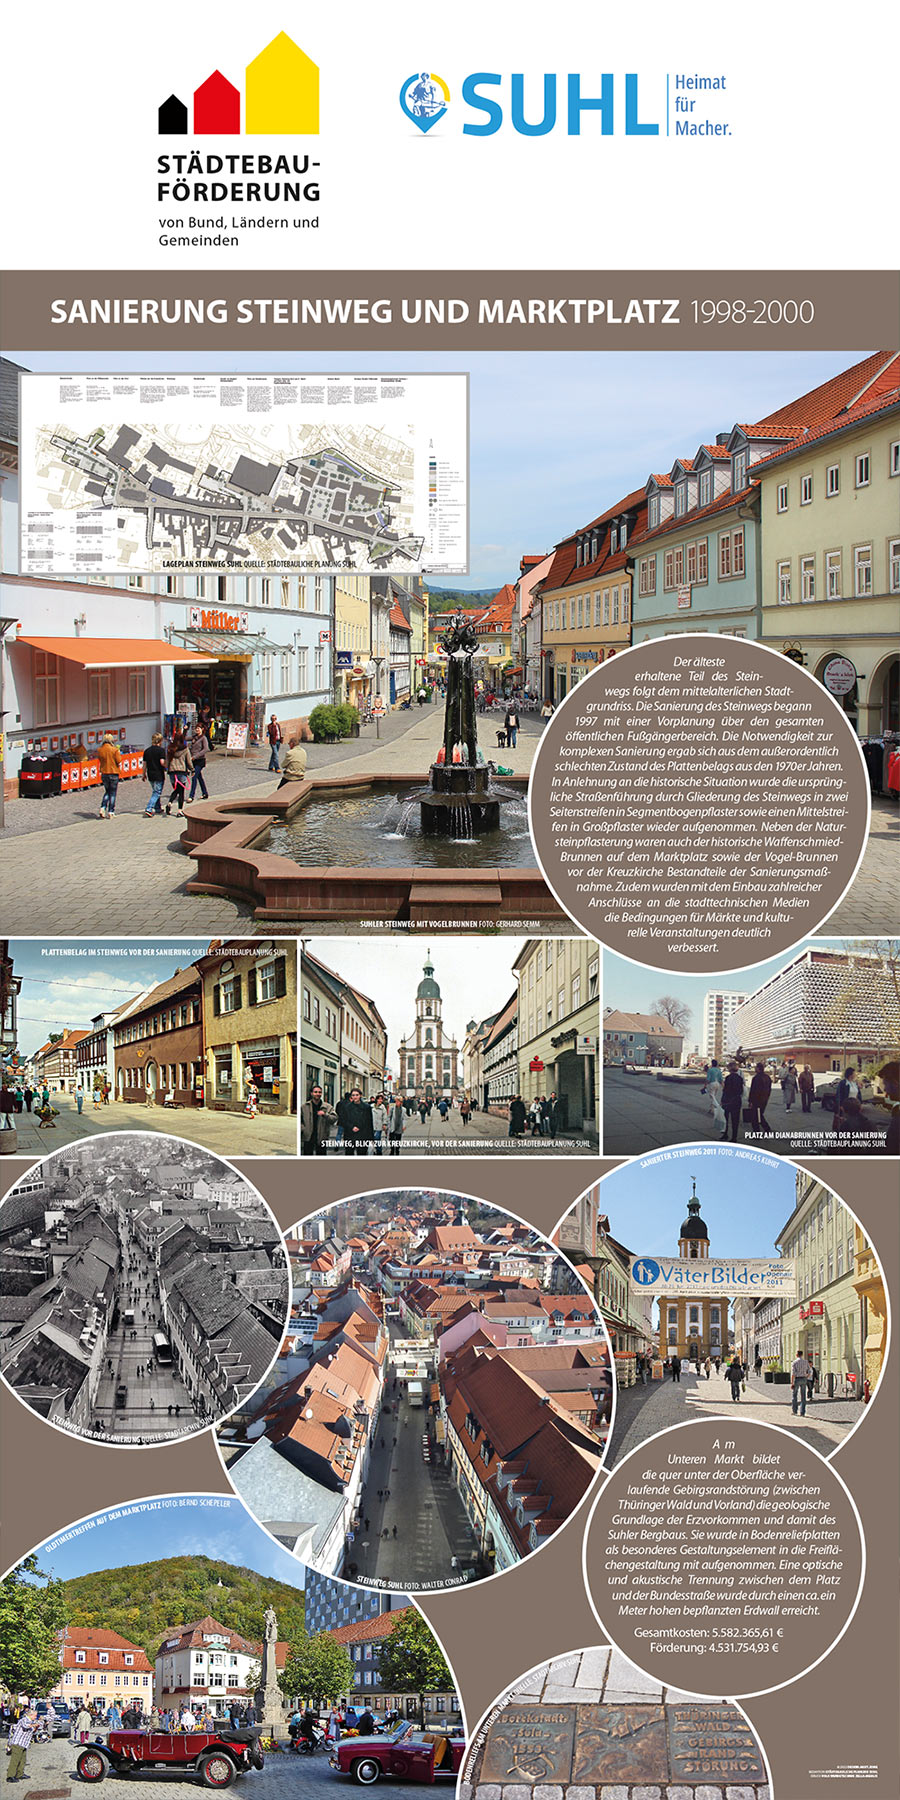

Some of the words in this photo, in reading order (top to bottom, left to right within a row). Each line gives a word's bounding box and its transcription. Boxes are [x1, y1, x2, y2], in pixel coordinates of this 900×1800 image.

[676, 74, 726, 89] Heimat
[462, 72, 659, 136] SUHL
[675, 96, 696, 112] für
[676, 120, 732, 136] Macher.
[158, 150, 320, 174] STÄDTEBAU-
[158, 178, 320, 202] FÖRDERUNG
[159, 219, 184, 228] von
[189, 216, 227, 230] Bund,
[232, 216, 288, 228] Ländern
[293, 216, 319, 228] und
[159, 234, 238, 246] Gemeinden
[51, 300, 227, 323] SANIERUNG
[237, 300, 392, 323] STEINWEG
[402, 300, 469, 323] UND
[478, 300, 680, 323] MARKTPLATZ
[691, 300, 814, 323] 1998-2000
[163, 560, 193, 568] LAGEPLAN
[196, 560, 225, 568] STEINWEG
[227, 560, 242, 568] SUHL
[244, 560, 265, 568] QUELLE:
[267, 560, 312, 568] STÄDTEBAULICHE
[315, 560, 341, 568] PLANUNG
[342, 560, 356, 568] SUHL
[201, 609, 240, 631] Müller
[674, 657, 692, 666] Der
[693, 657, 725, 666] älteste
[635, 671, 681, 681] erhaltene
[689, 671, 704, 681] Teil
[712, 671, 728, 681] des
[736, 671, 763, 681] Stein-
[605, 688, 630, 698] wegs
[633, 686, 656, 698] folgt
[658, 686, 680, 696] dem
[682, 686, 762, 696] mittelalterlichen
[764, 686, 793, 696] Stadt-
[586, 701, 634, 713] grundriss.
[636, 701, 653, 711] Die
[654, 701, 703, 713] Sanierung
[705, 701, 722, 711] des
[723, 701, 772, 713] Steinwegs
[774, 701, 812, 713] begann
[576, 717, 598, 726] 1997
[604, 716, 620, 726] mit
[627, 716, 651, 726] einer
[658, 716, 715, 728] Vorplanung
[721, 716, 744, 726] über
[750, 716, 769, 726] den
[775, 718, 824, 728] gesamten
[41, 948, 87, 956] PLATTENBELAG
[88, 948, 96, 956] IM
[97, 948, 128, 956] STEINWEG
[129, 948, 141, 956] VOR
[143, 948, 154, 956] DER
[156, 948, 190, 956] SANIERUNG
[192, 948, 213, 956] QUELLE:
[215, 948, 272, 956] STÄDTEBAUPLANUNG
[274, 948, 288, 956] SUHL
[668, 942, 718, 952] verbessert.
[640, 1153, 671, 1168] SANIERTER
[673, 1148, 702, 1159] STEINWEG
[718, 1148, 734, 1156] FOTO:
[735, 1150, 761, 1162] ANDREAS
[659, 1266, 766, 1285] VäterBilder
[52, 1415, 80, 1432] STEINWEG
[81, 1428, 93, 1437] VOR
[93, 1432, 105, 1440] DER
[106, 1434, 140, 1443] SANIERUNG
[142, 1434, 164, 1442] QUELLE:
[164, 1423, 200, 1439] STADTARCHIV
[668, 1454, 706, 1464] Unteren
[714, 1454, 744, 1464] Markt
[753, 1454, 780, 1464] bildet
[642, 1470, 657, 1479] die
[659, 1472, 682, 1482] quer
[684, 1471, 710, 1479] unter
[712, 1470, 729, 1479] der
[731, 1470, 785, 1479] Oberfläche
[627, 1485, 670, 1494] laufende
[673, 1485, 769, 1497] Gebirgsrandstörung
[773, 1485, 820, 1496] (zwischen
[45, 1521, 96, 1552] OLDTIMERTREFFEN
[96, 1515, 107, 1526] AUF
[108, 1510, 122, 1521] DEM
[122, 1502, 161, 1517] MARKTPLATZ
[200, 1499, 231, 1508] SCHEPELER
[356, 1576, 386, 1587] STEINWEG
[387, 1581, 403, 1589] SUHL
[404, 1582, 420, 1590] FOTO:
[422, 1580, 444, 1589] WALTER
[445, 1575, 468, 1586] CONRAD
[618, 1606, 648, 1615] Meter
[649, 1605, 681, 1615] hohen
[683, 1605, 741, 1617] bepflanzten
[744, 1605, 780, 1615] Erdwall
[782, 1606, 820, 1615] erreicht.
[634, 1628, 709, 1637] Gesamtkosten:
[712, 1628, 772, 1638] 5.582.365,61
[777, 1628, 783, 1637] €
[651, 1642, 706, 1654] Förderung:
[709, 1643, 769, 1653] 4.531.754,93
[772, 1643, 778, 1652] €
[675, 1708, 744, 1720] THÜRINGER
[696, 1722, 730, 1731] WALD
[688, 1738, 744, 1747] GEBIRGS
[684, 1759, 748, 1772] STÖRUNG
